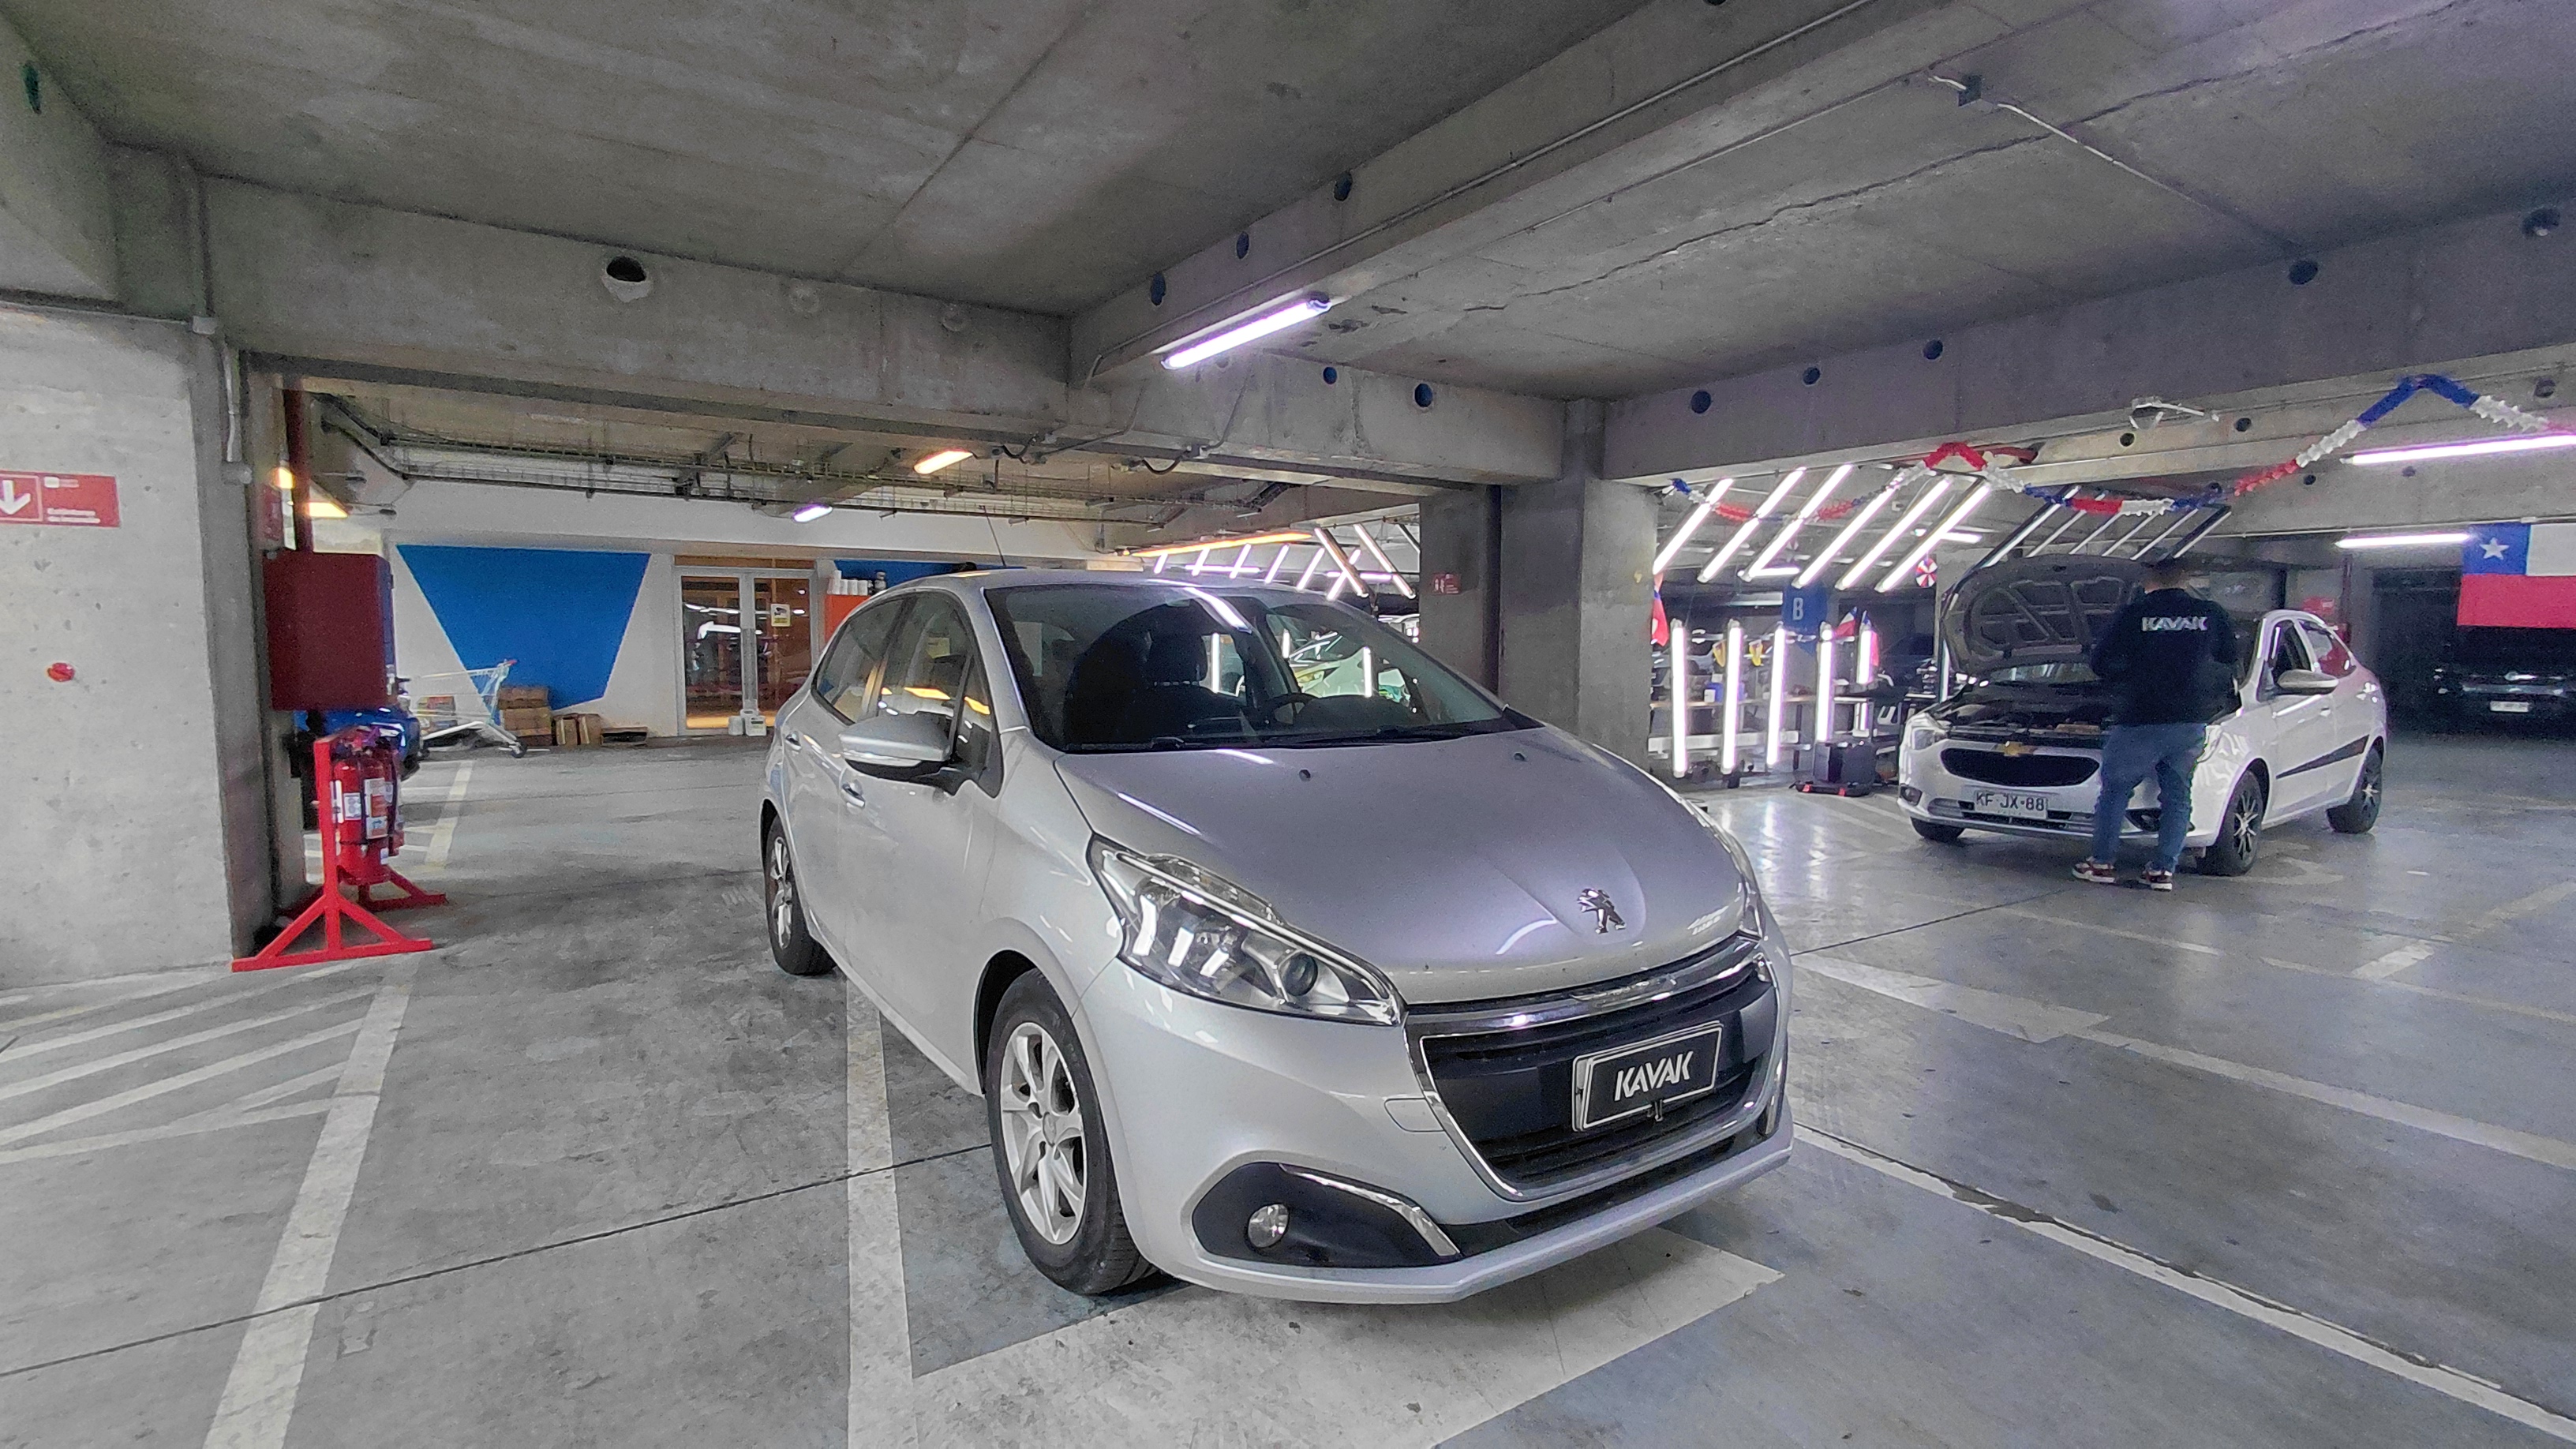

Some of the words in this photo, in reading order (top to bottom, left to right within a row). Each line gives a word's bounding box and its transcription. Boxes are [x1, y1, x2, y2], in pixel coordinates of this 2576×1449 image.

[1792, 597, 1804, 621] B
[2142, 616, 2208, 631] KAVAK
[1614, 1050, 1694, 1102] KAVAK
